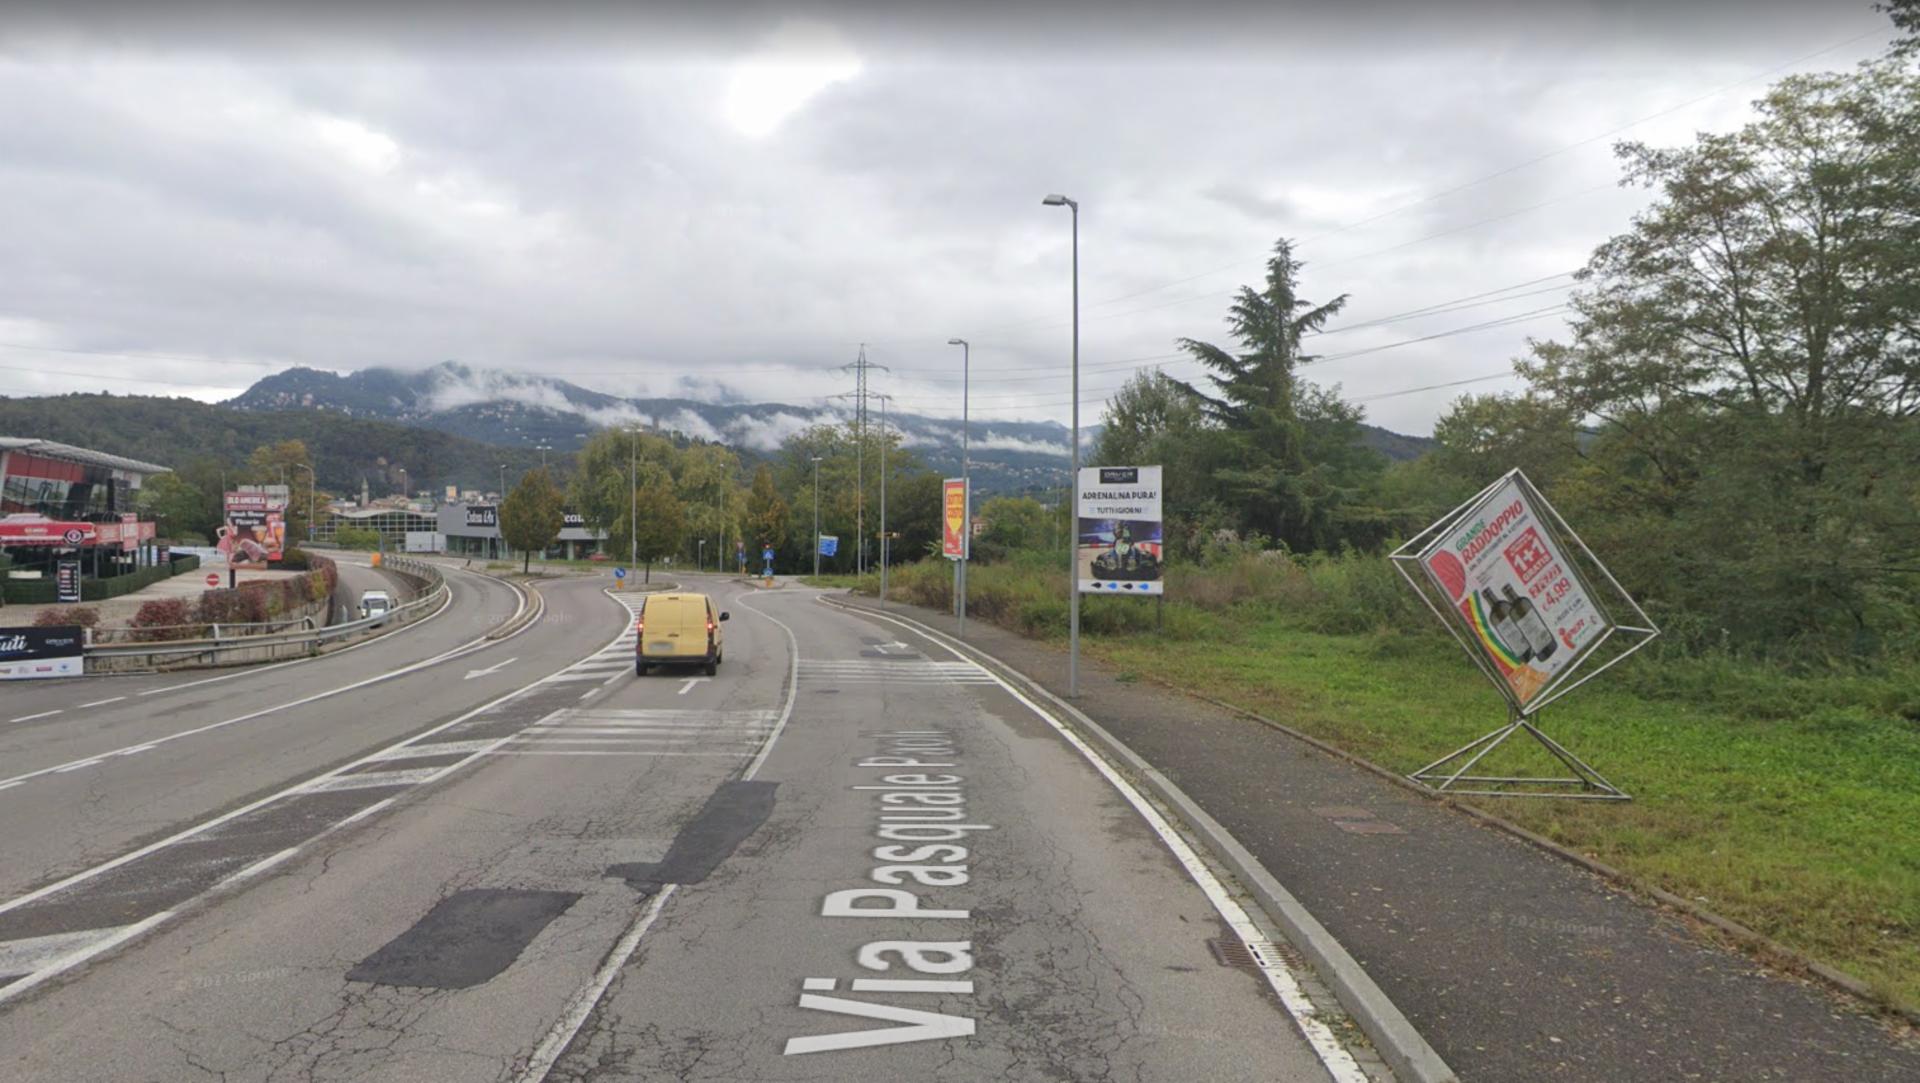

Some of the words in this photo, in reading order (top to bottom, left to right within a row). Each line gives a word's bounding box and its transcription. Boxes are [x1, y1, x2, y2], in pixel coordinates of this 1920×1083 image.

[1082, 491, 1130, 500] ADRENALINA
[1460, 499, 1524, 565] RADDOPPIO
[1512, 537, 1547, 573] 1+1
[1544, 576, 1573, 608] 4,99
